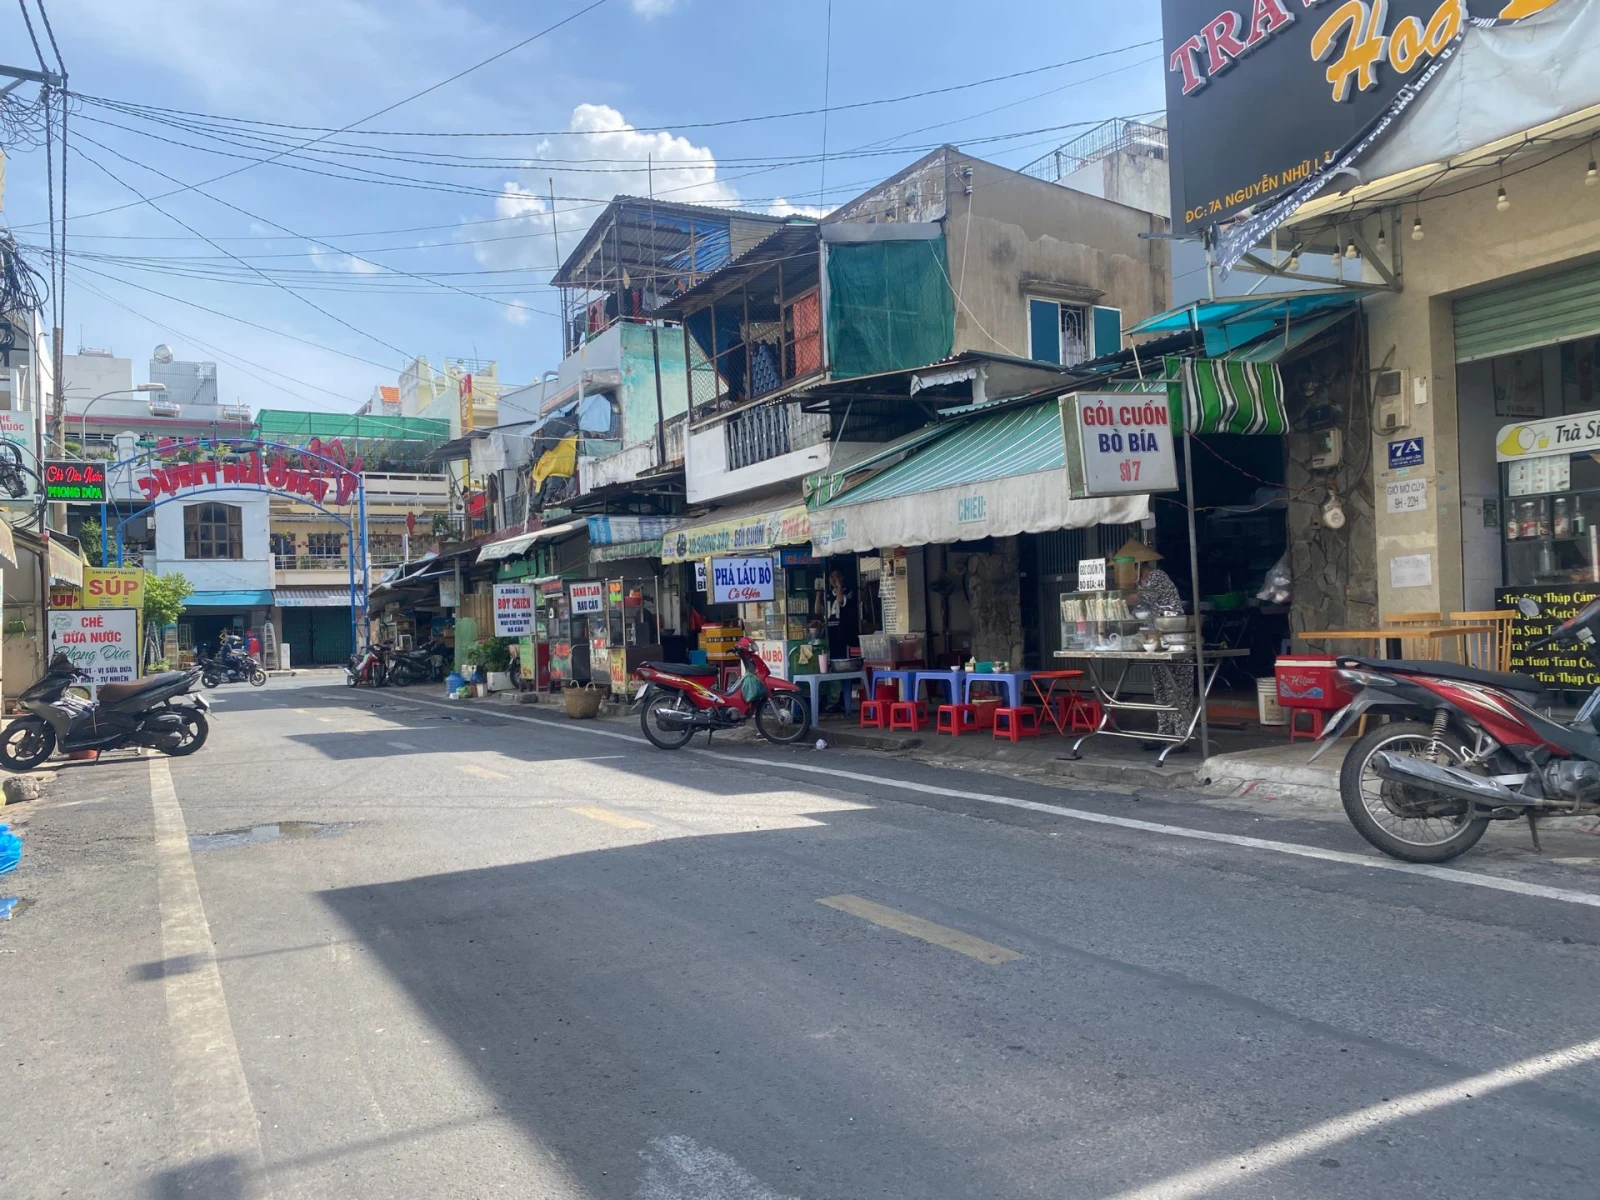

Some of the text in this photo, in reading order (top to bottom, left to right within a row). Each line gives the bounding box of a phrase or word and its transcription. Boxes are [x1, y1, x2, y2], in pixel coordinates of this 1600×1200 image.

[1208, 200, 1222, 215] 7A
[1225, 173, 1279, 208] NGUYỄN
[1083, 400, 1168, 426] GỎI CUỐN
[1098, 428, 1159, 453] BÒ BÍA
[1556, 423, 1581, 444] Trà
[1392, 440, 1421, 457] 7A
[1120, 459, 1141, 482] SỐ 7
[47, 485, 103, 499] PHONG DỪA
[715, 559, 771, 586] PHÁ LẤU BÒ
[89, 576, 139, 596] SÚP
[577, 601, 588, 611] RAU
[1544, 592, 1571, 605] Thập
[81, 615, 104, 628] CHÈ
[63, 630, 122, 644] DỪA NƯỚC
[100, 645, 132, 660] Dừa
